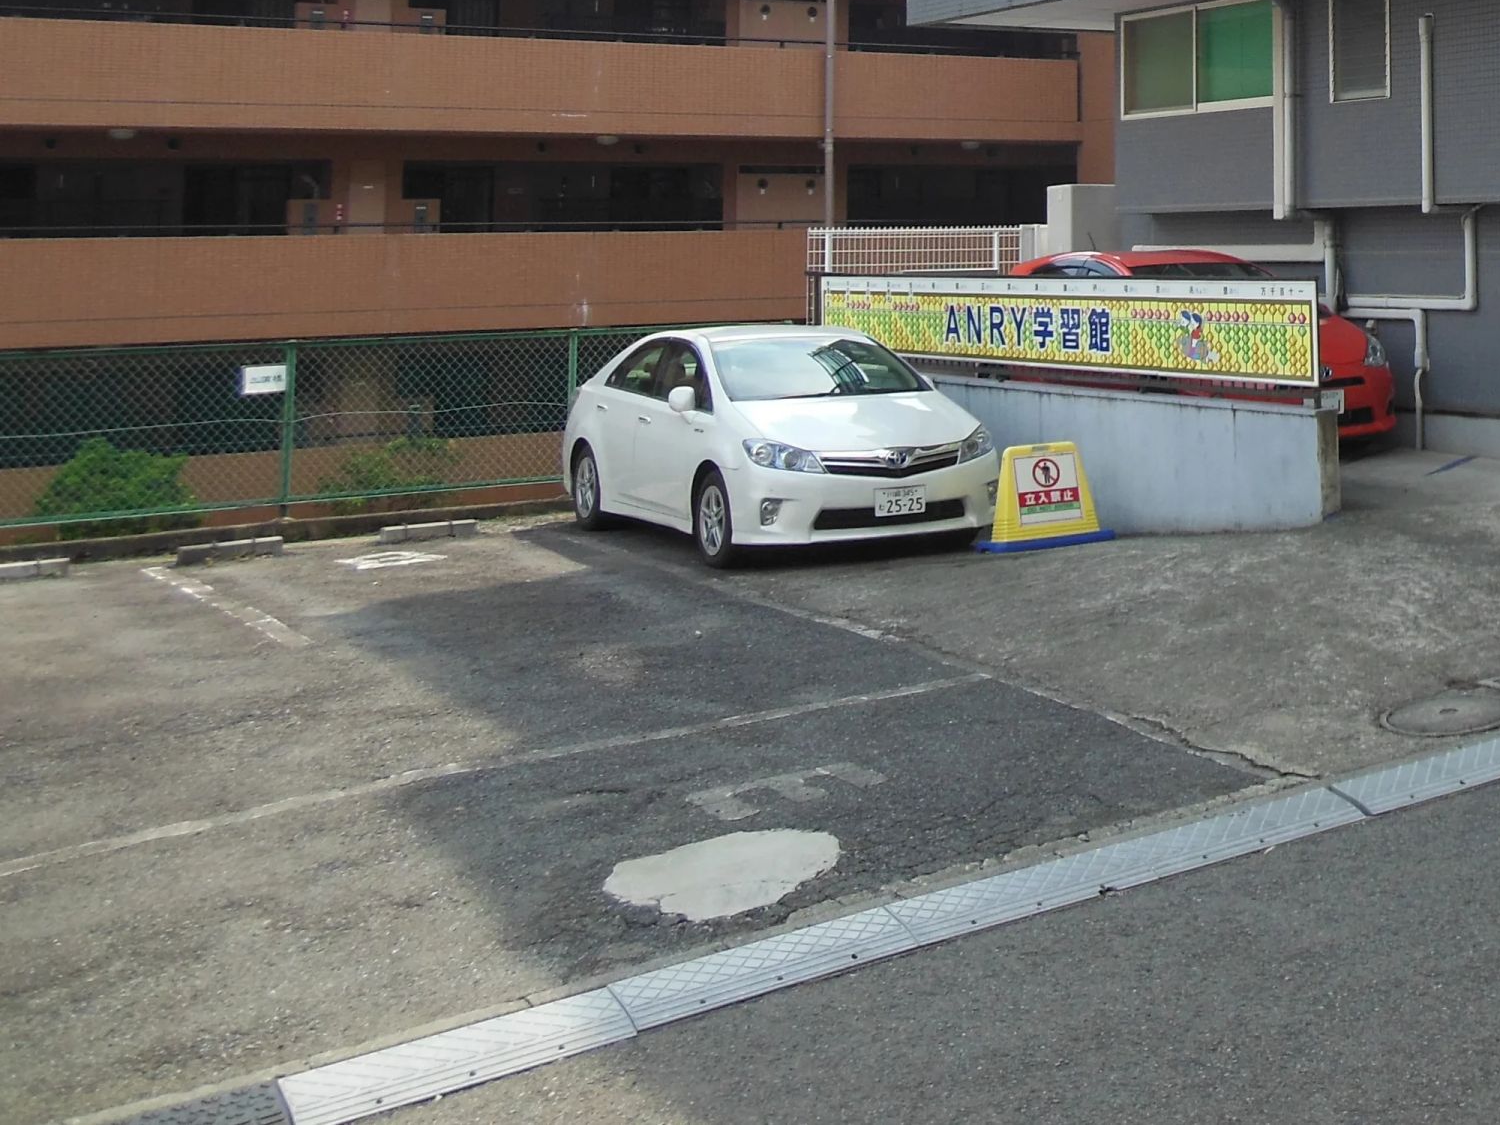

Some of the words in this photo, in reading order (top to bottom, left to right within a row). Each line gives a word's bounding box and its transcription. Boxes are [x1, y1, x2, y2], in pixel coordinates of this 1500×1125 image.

[944, 304, 1111, 353] ANRY学習館
[886, 497, 923, 514] 25-25
[1024, 489, 1075, 506] 立入禁止
